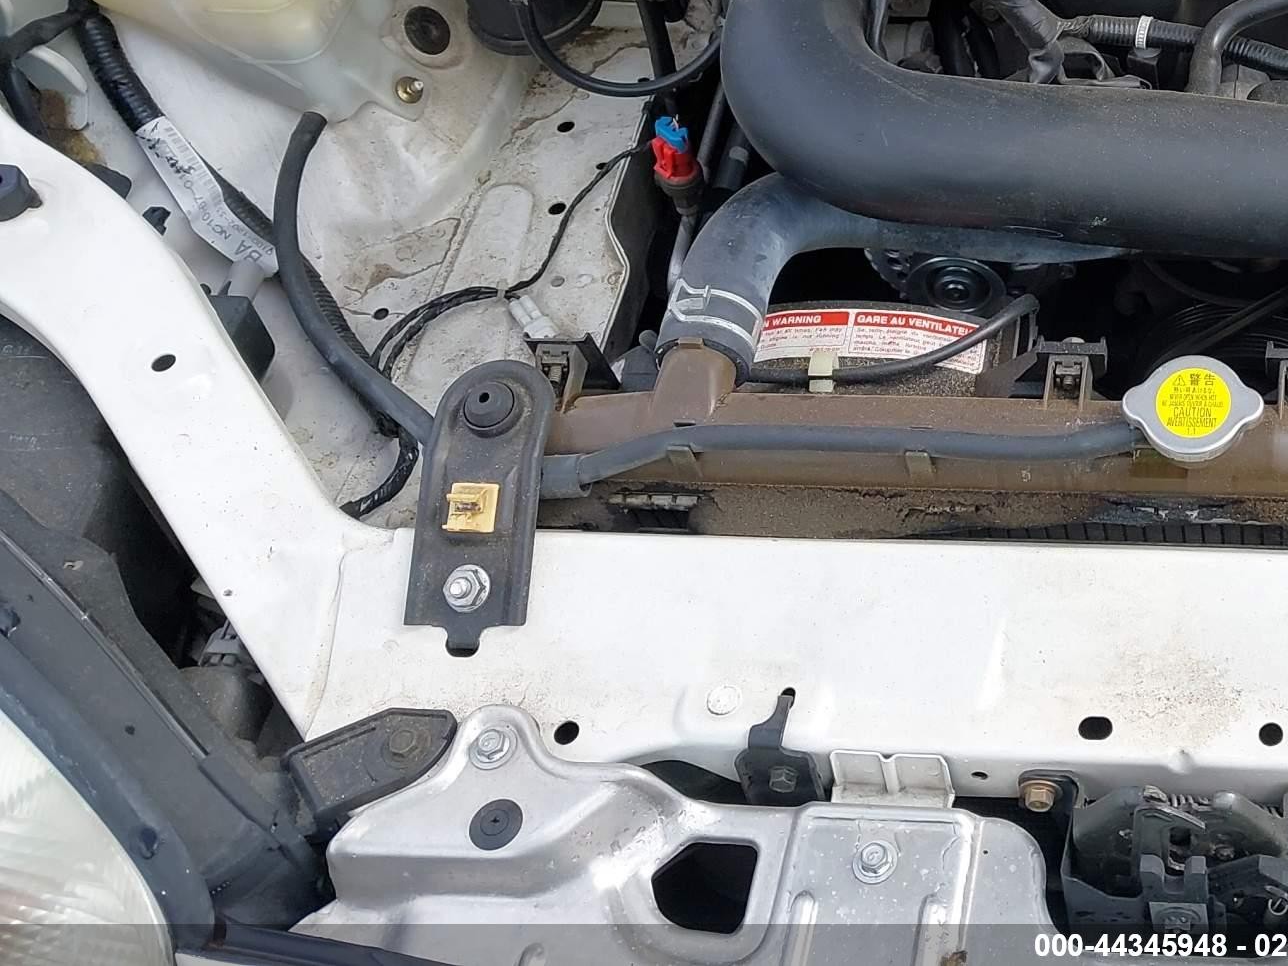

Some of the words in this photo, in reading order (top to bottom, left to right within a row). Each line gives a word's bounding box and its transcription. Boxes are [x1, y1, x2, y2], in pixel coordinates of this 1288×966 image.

[772, 315, 822, 326] WARNING
[857, 314, 888, 324] GARE
[892, 316, 906, 325] AU
[908, 317, 976, 336] VENTILATEU
[1190, 373, 1216, 386] 警告
[1174, 407, 1212, 418] CAUTION
[1166, 417, 1218, 428] AVERTISSEMENT
